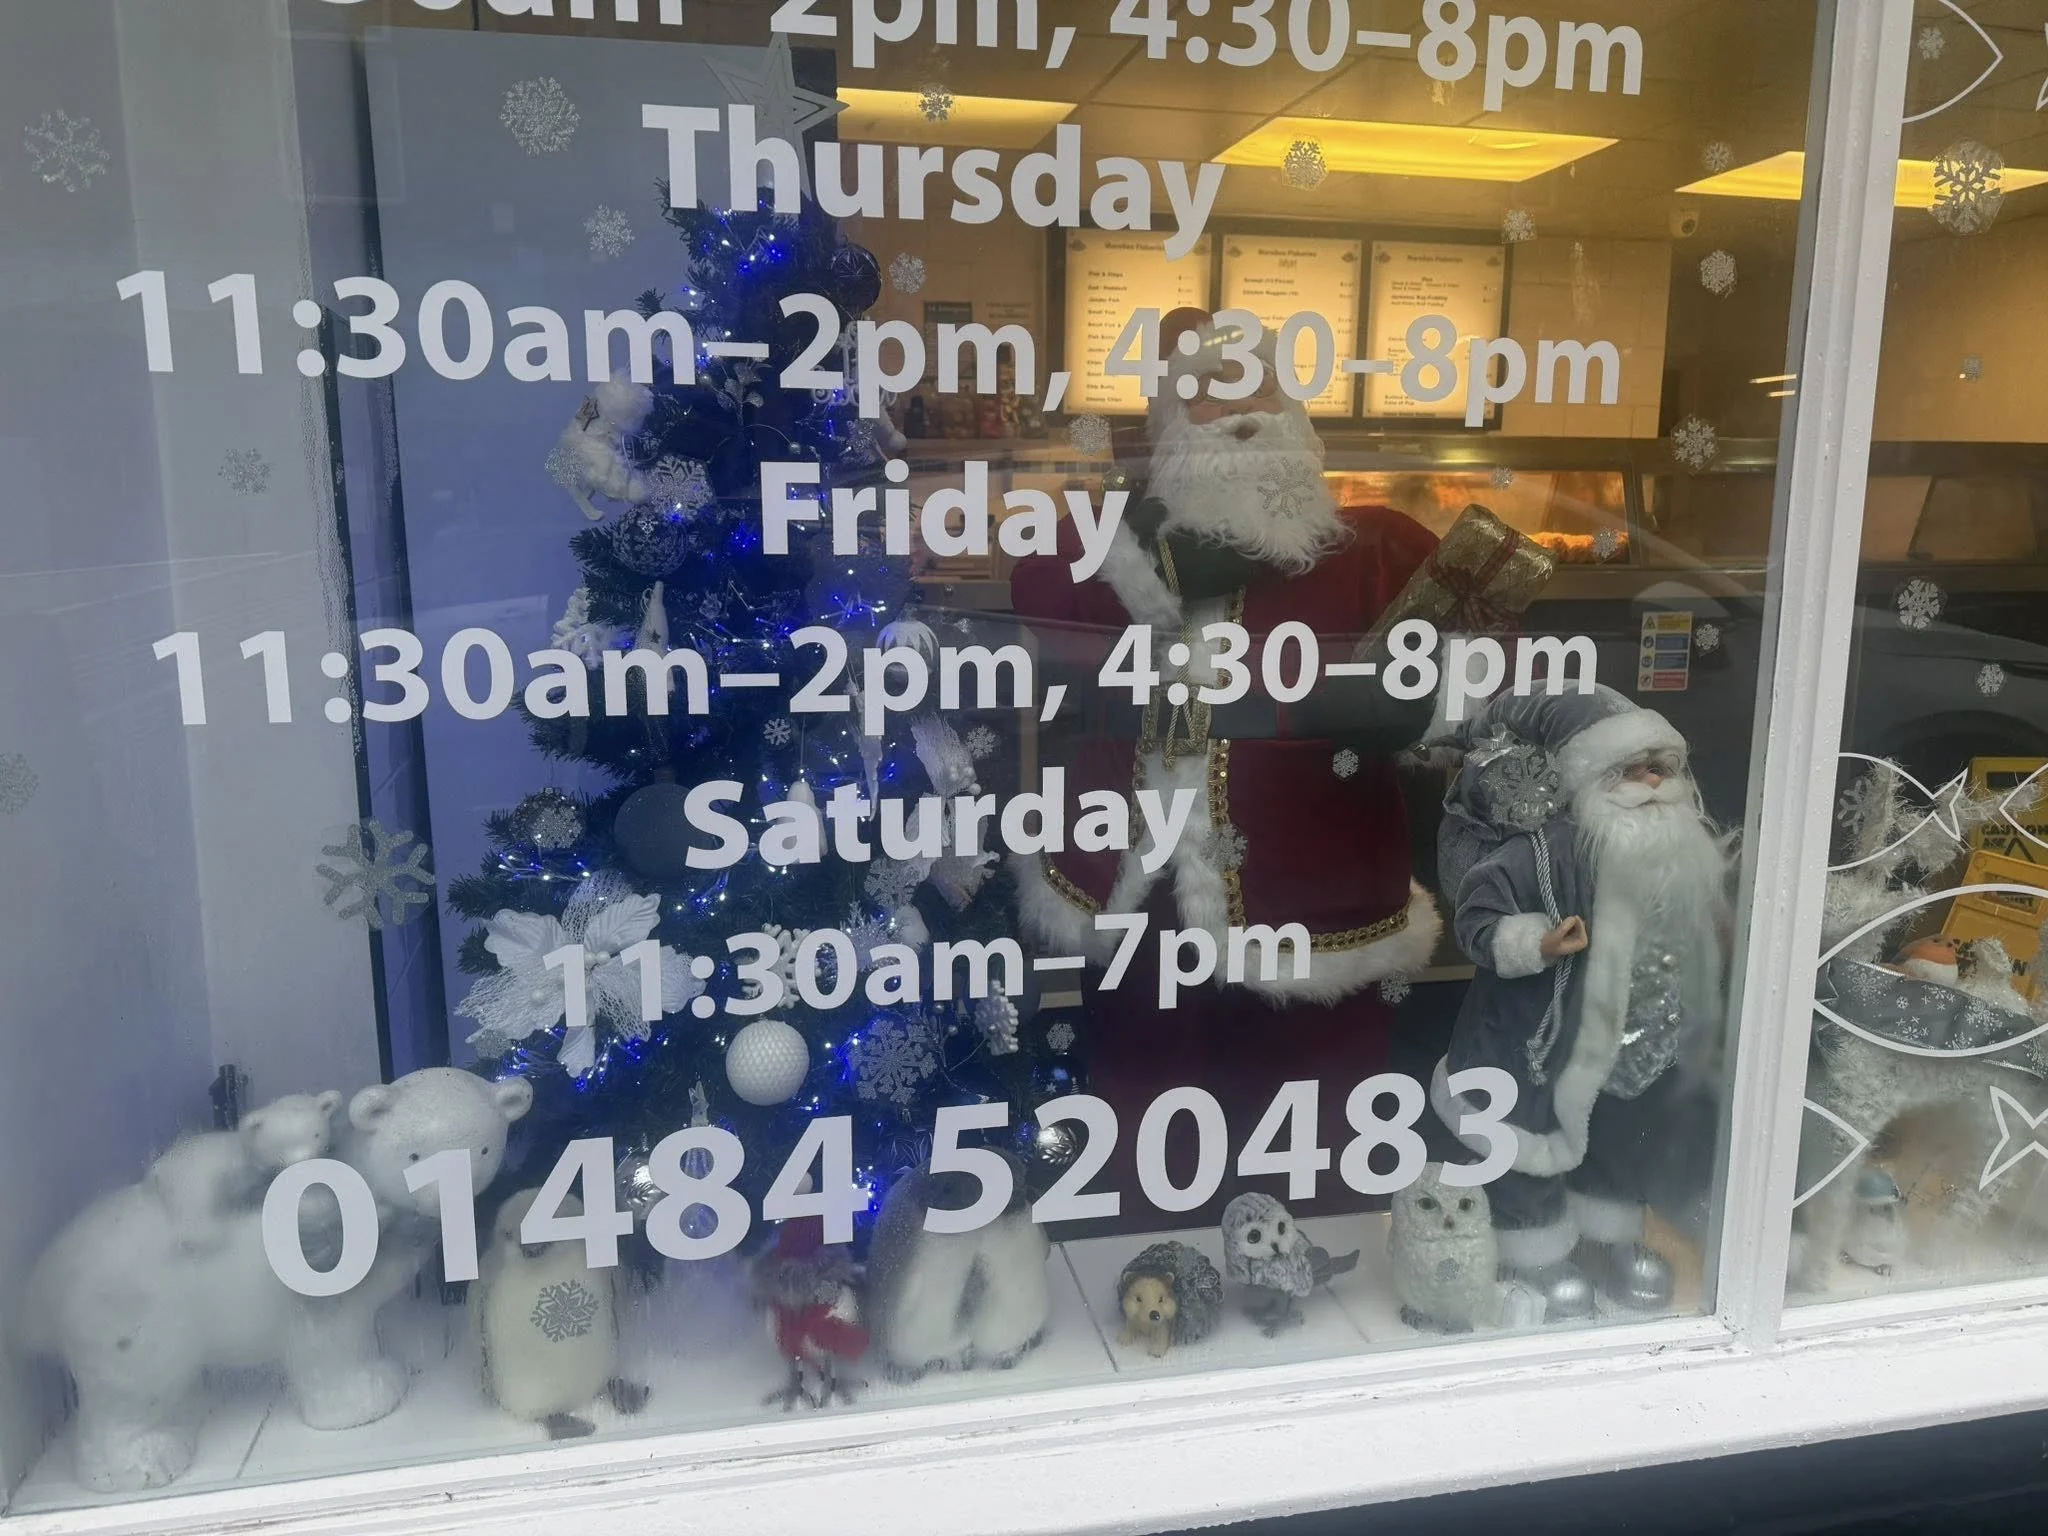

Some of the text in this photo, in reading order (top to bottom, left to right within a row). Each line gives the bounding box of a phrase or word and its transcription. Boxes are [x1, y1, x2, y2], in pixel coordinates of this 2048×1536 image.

[1109, 0, 1643, 112] 4:30–8pm
[641, 103, 1226, 261] Thursday
[116, 270, 1071, 418] 11:30am–2pm,
[1104, 307, 1620, 427] 4:30–8pm
[760, 459, 1130, 583] Friday
[152, 625, 1067, 736] 11:30am–2pm,
[1098, 619, 1598, 721] 4:30–8pm
[683, 766, 1198, 873] Saturday
[543, 912, 1311, 1027] 11:30am–7pm
[261, 1066, 1519, 1297] 01484 520483
